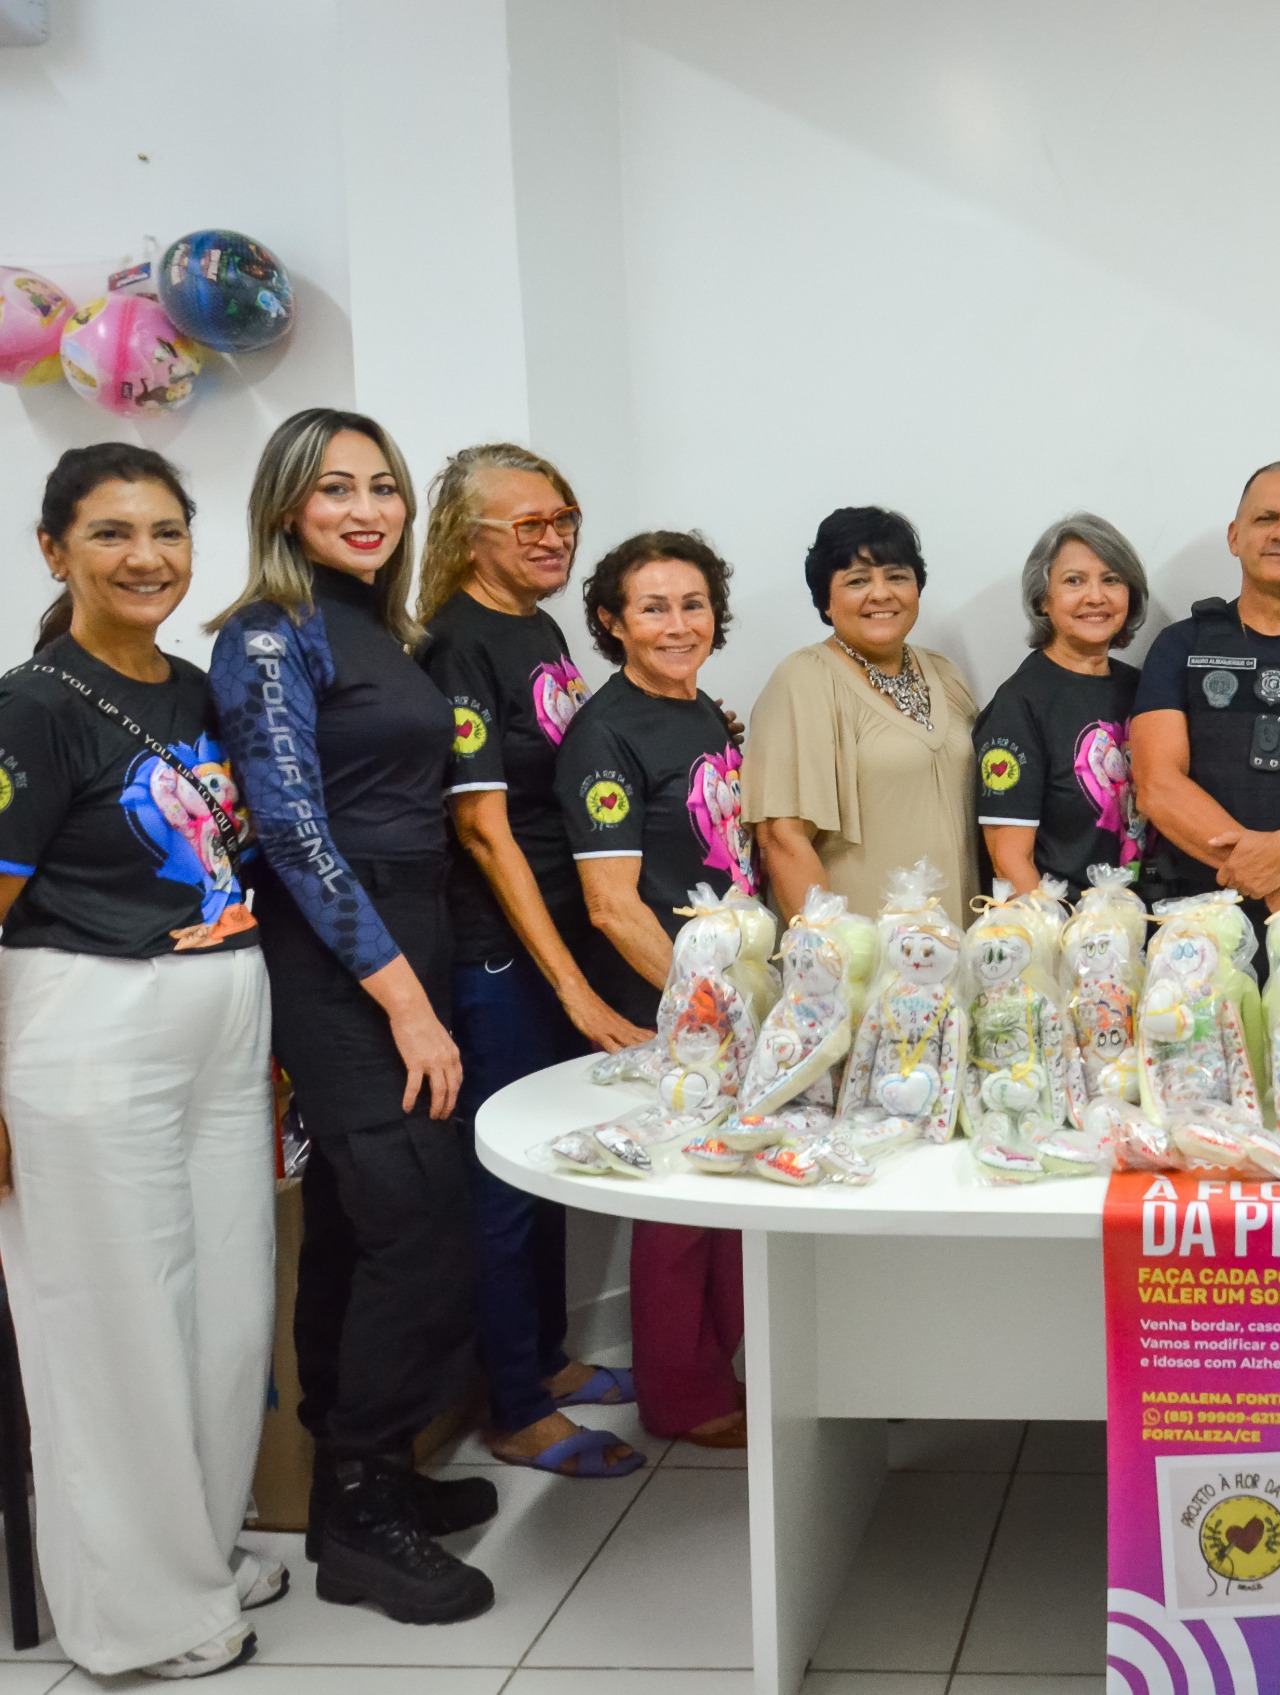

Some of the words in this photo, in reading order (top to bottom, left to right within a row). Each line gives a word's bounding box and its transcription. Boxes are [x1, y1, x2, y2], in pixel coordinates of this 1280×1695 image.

[32, 664, 55, 673] TO
[62, 671, 92, 696] YOU
[98, 698, 119, 714] UP
[122, 715, 141, 735] TO
[144, 734, 172, 760] YOU
[177, 763, 194, 780] UP
[198, 785, 210, 802] TO
[211, 803, 232, 832] YOU
[256, 657, 303, 786] POLICIA
[288, 798, 343, 894] PENAL
[1143, 1174, 1178, 1200] À
[1143, 1201, 1216, 1257] DA
[1138, 1267, 1195, 1288] FAÇA
[1199, 1268, 1260, 1286] CADA
[1138, 1286, 1207, 1304] VALER
[1213, 1288, 1245, 1304] UM
[1140, 1318, 1187, 1331] Venha
[1191, 1319, 1244, 1334] bordar,
[1140, 1337, 1190, 1350] Vamos
[1194, 1337, 1266, 1350] modificar
[1270, 1341, 1279, 1351] o
[1140, 1358, 1149, 1368] e
[1153, 1355, 1201, 1368] idosos
[1204, 1359, 1237, 1369] com
[1142, 1391, 1232, 1405] MADALENA
[1164, 1409, 1194, 1425] (85)
[1142, 1429, 1261, 1443] FORTALEZA/CE
[1181, 1483, 1216, 1529] PROJETO
[1219, 1473, 1231, 1491] À
[1235, 1472, 1260, 1489] FLOR
[1264, 1478, 1280, 1498] DA
